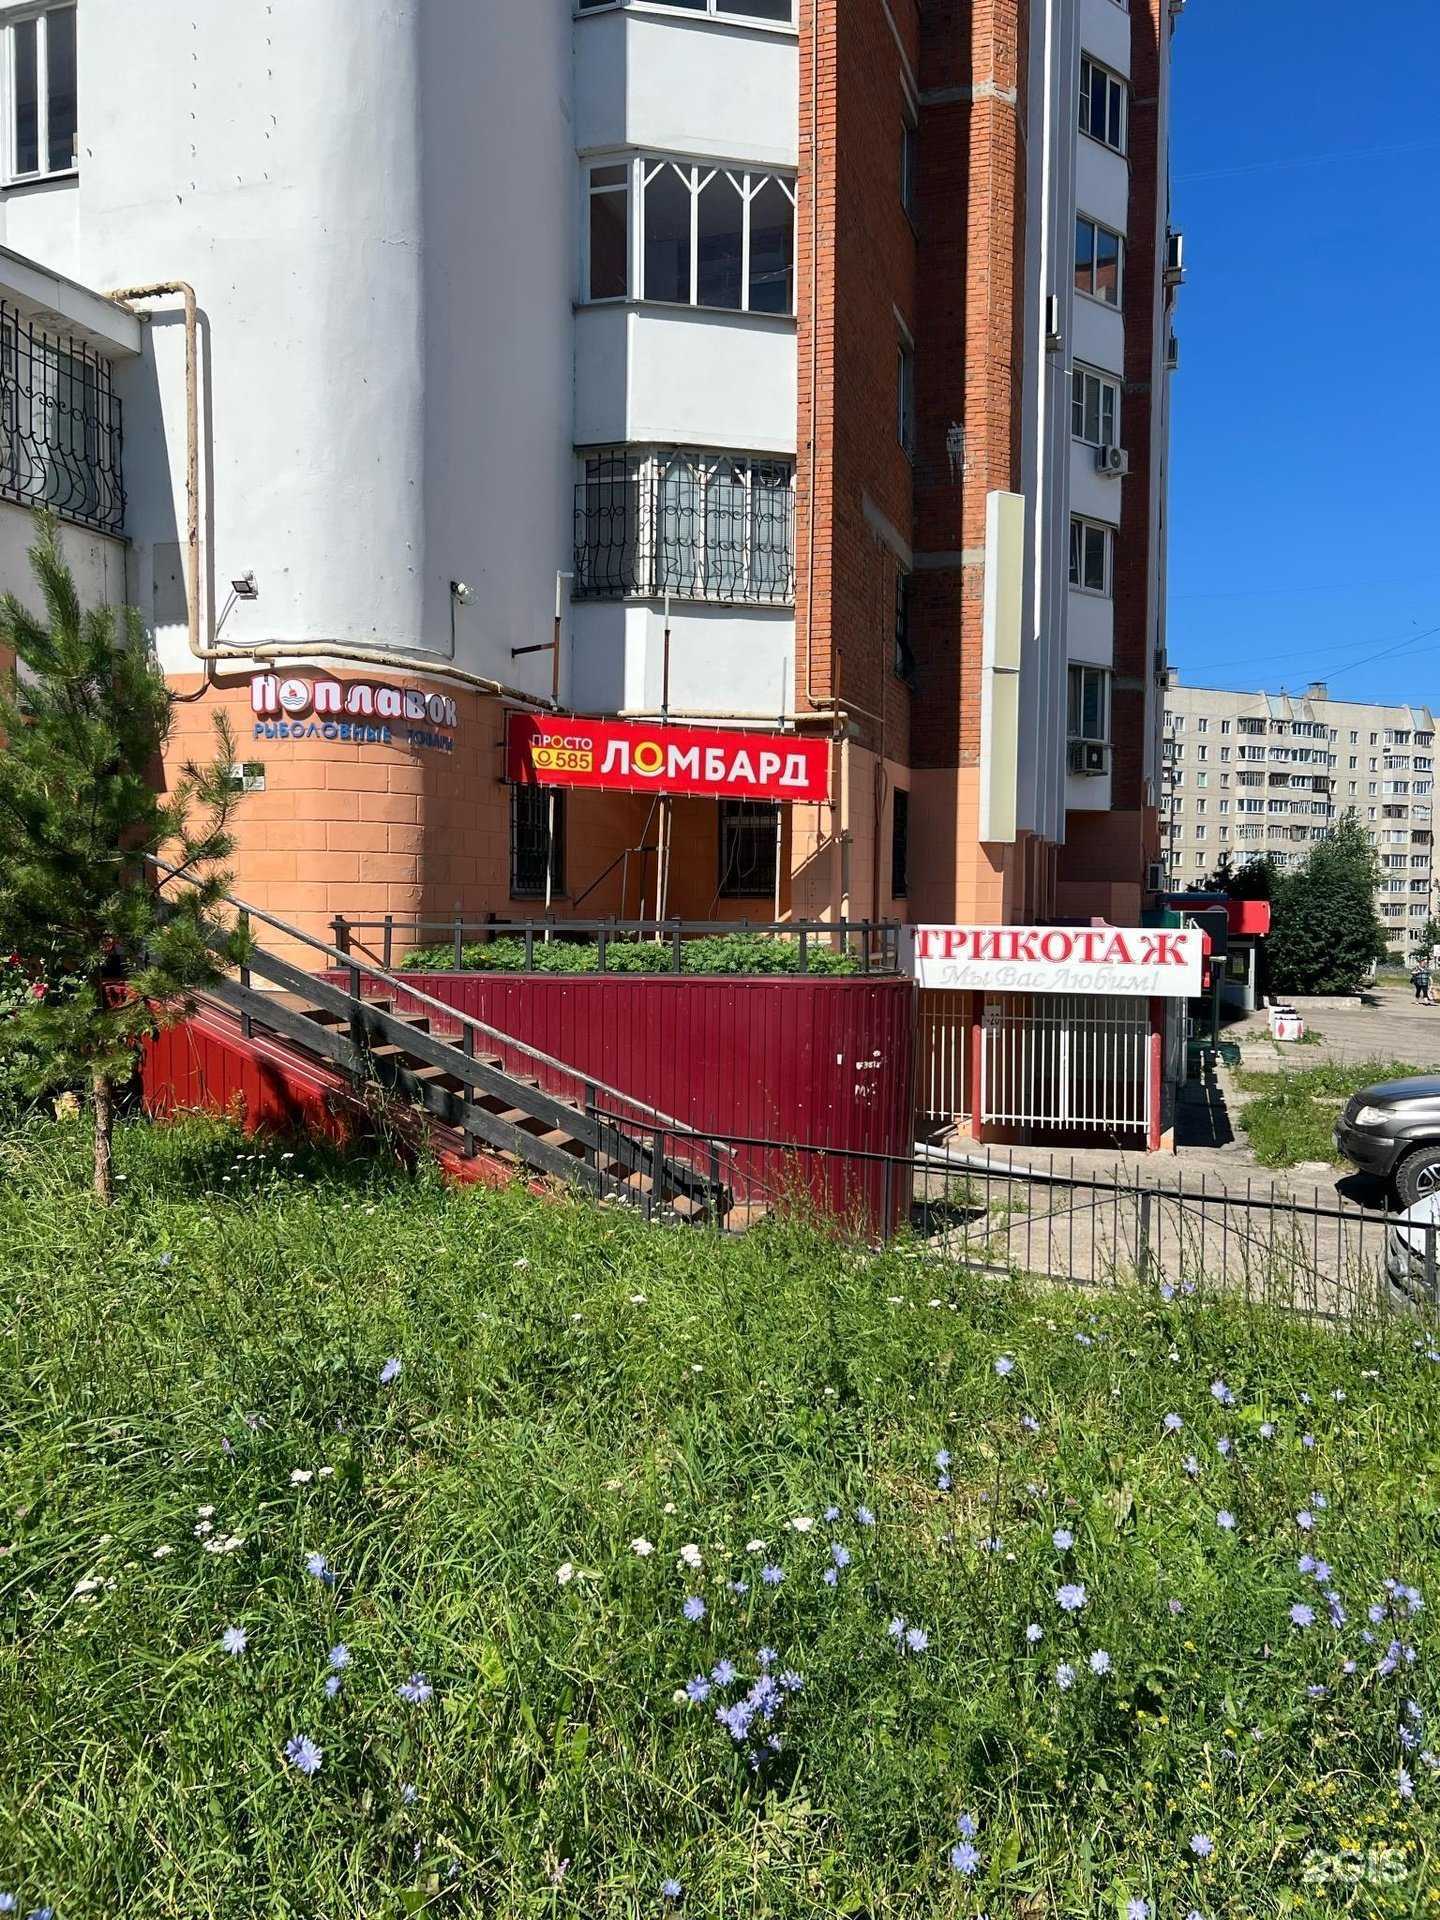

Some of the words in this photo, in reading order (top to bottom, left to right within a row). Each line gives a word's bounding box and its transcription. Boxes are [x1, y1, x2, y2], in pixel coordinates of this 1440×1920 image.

[254, 721, 392, 744] РЫБОЛОВНЫЕ
[532, 734, 592, 750] ПРОСТО
[601, 739, 809, 787] ЛОМБАРД
[940, 965, 992, 986] Мы
[994, 966, 1047, 988] Вас
[1046, 967, 1160, 992] Любим!
